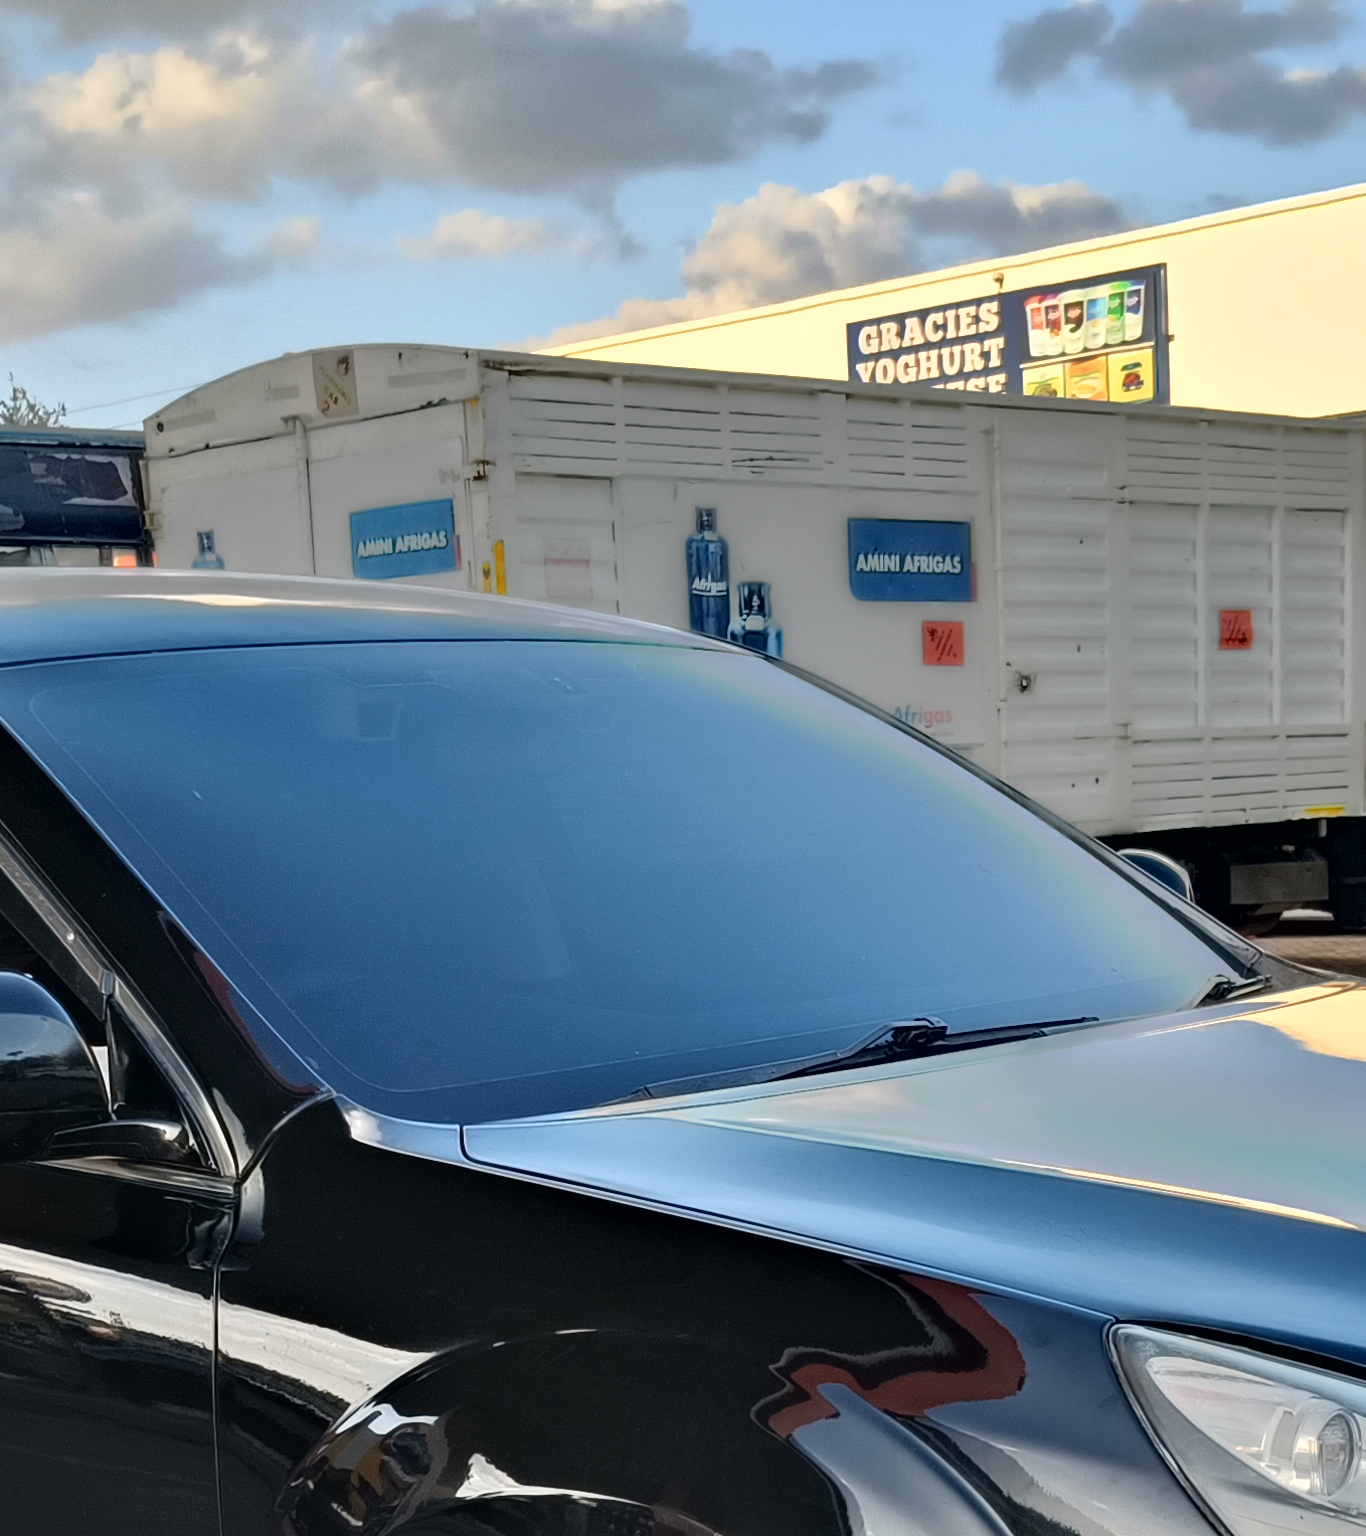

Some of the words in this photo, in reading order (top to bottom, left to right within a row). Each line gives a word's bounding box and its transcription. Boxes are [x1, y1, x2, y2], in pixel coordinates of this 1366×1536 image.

[858, 301, 1001, 355] GRACIES
[855, 336, 1006, 384] YOGHURT
[357, 538, 393, 559] AMINI
[395, 530, 448, 554] AFRIGAS
[856, 553, 900, 572] AMINI
[902, 555, 962, 574] AFRIGAS
